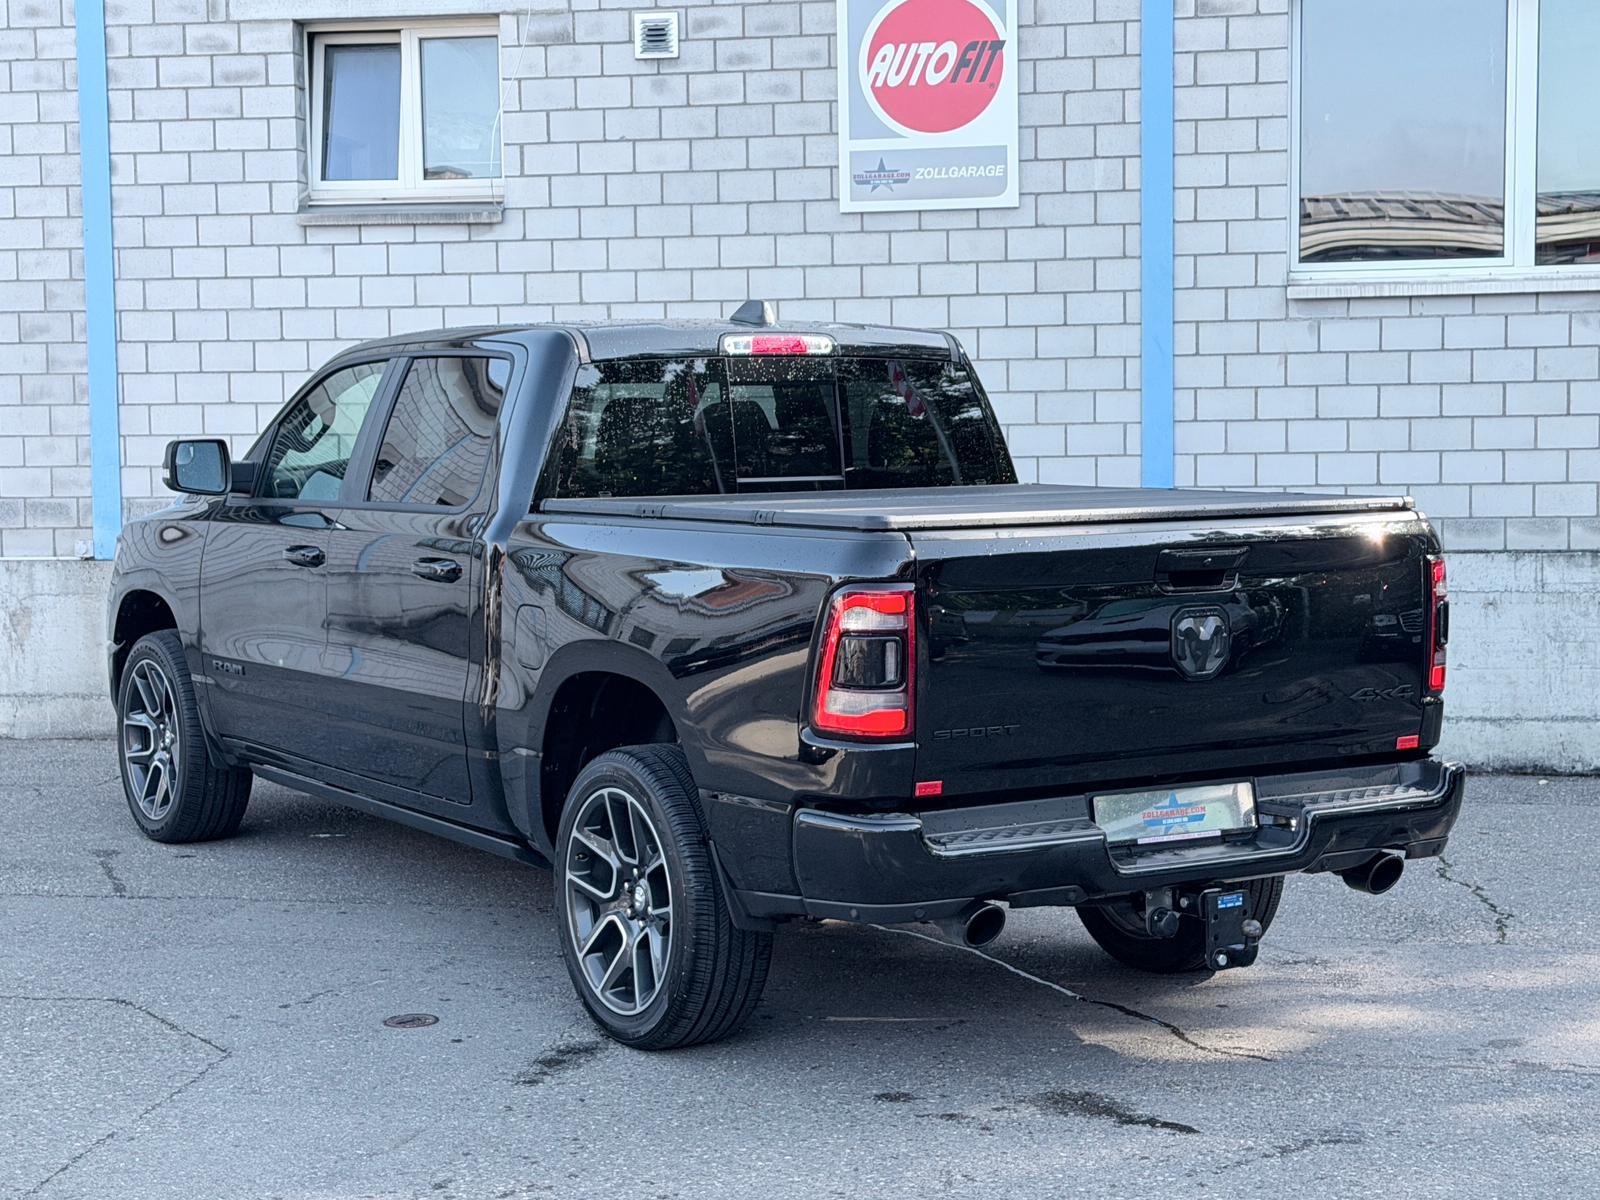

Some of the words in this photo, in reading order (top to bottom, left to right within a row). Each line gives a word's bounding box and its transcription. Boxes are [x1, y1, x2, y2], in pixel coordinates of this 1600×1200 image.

[868, 40, 1006, 88] AUTOFIT
[915, 165, 1005, 180] ZOLLGARAGE
[933, 724, 1020, 741] SPORT
